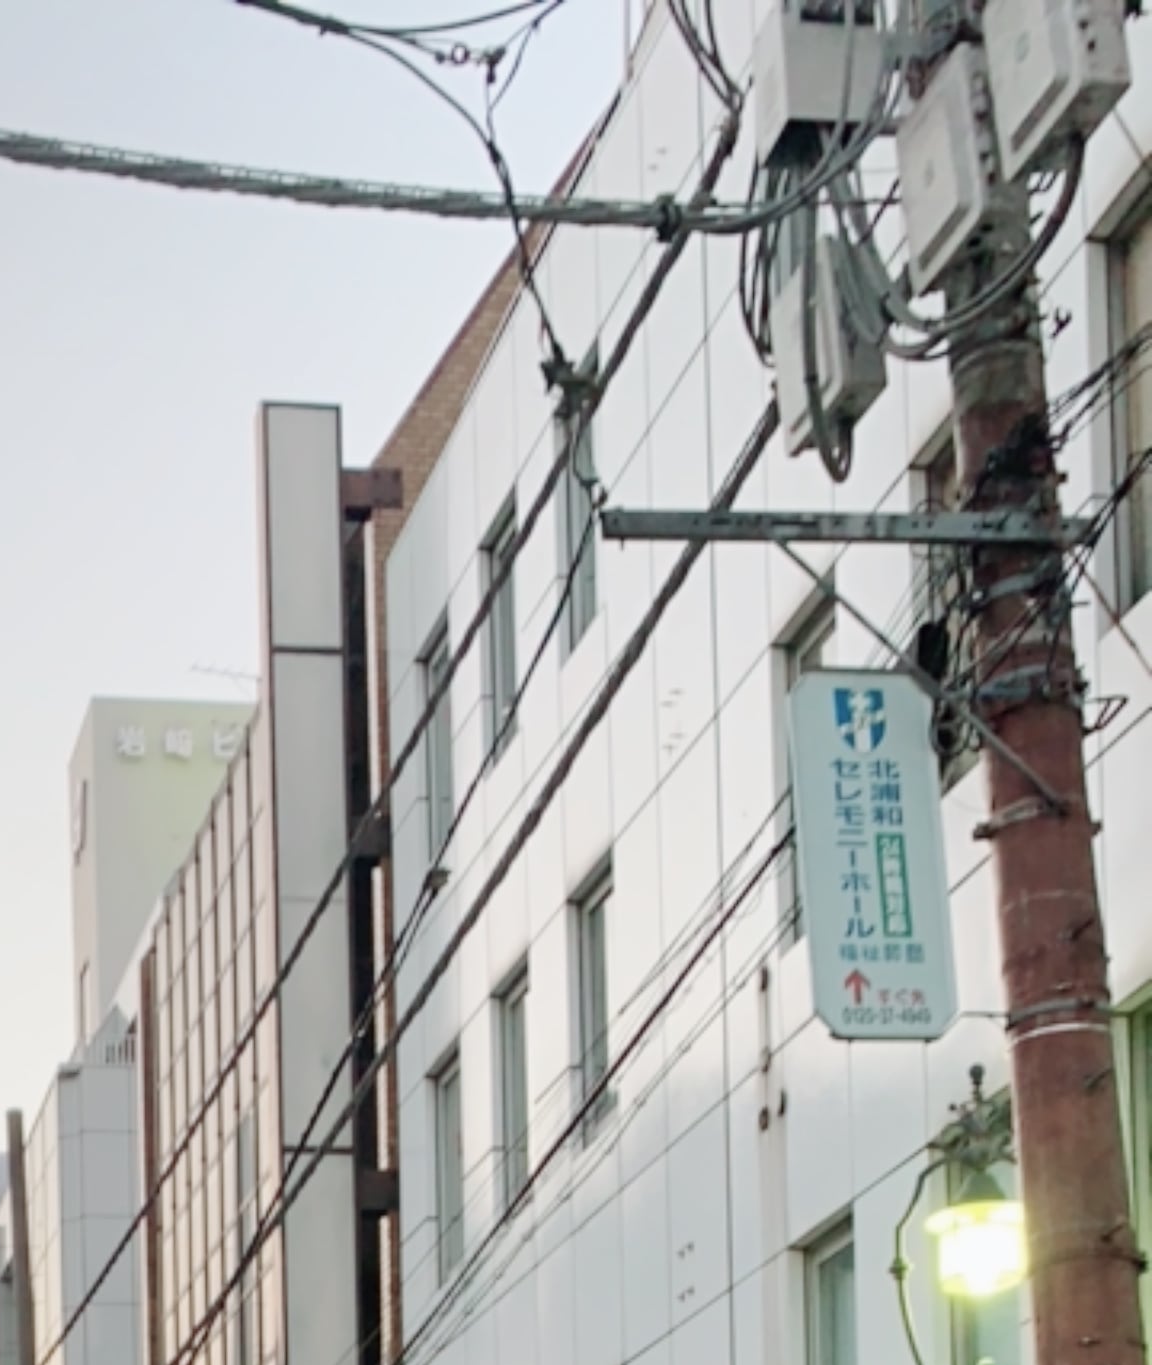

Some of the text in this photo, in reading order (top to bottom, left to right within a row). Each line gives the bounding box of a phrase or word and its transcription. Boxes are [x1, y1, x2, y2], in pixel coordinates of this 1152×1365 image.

[831, 757, 876, 939] セレモニーホール
[869, 758, 905, 827] 北浦和
